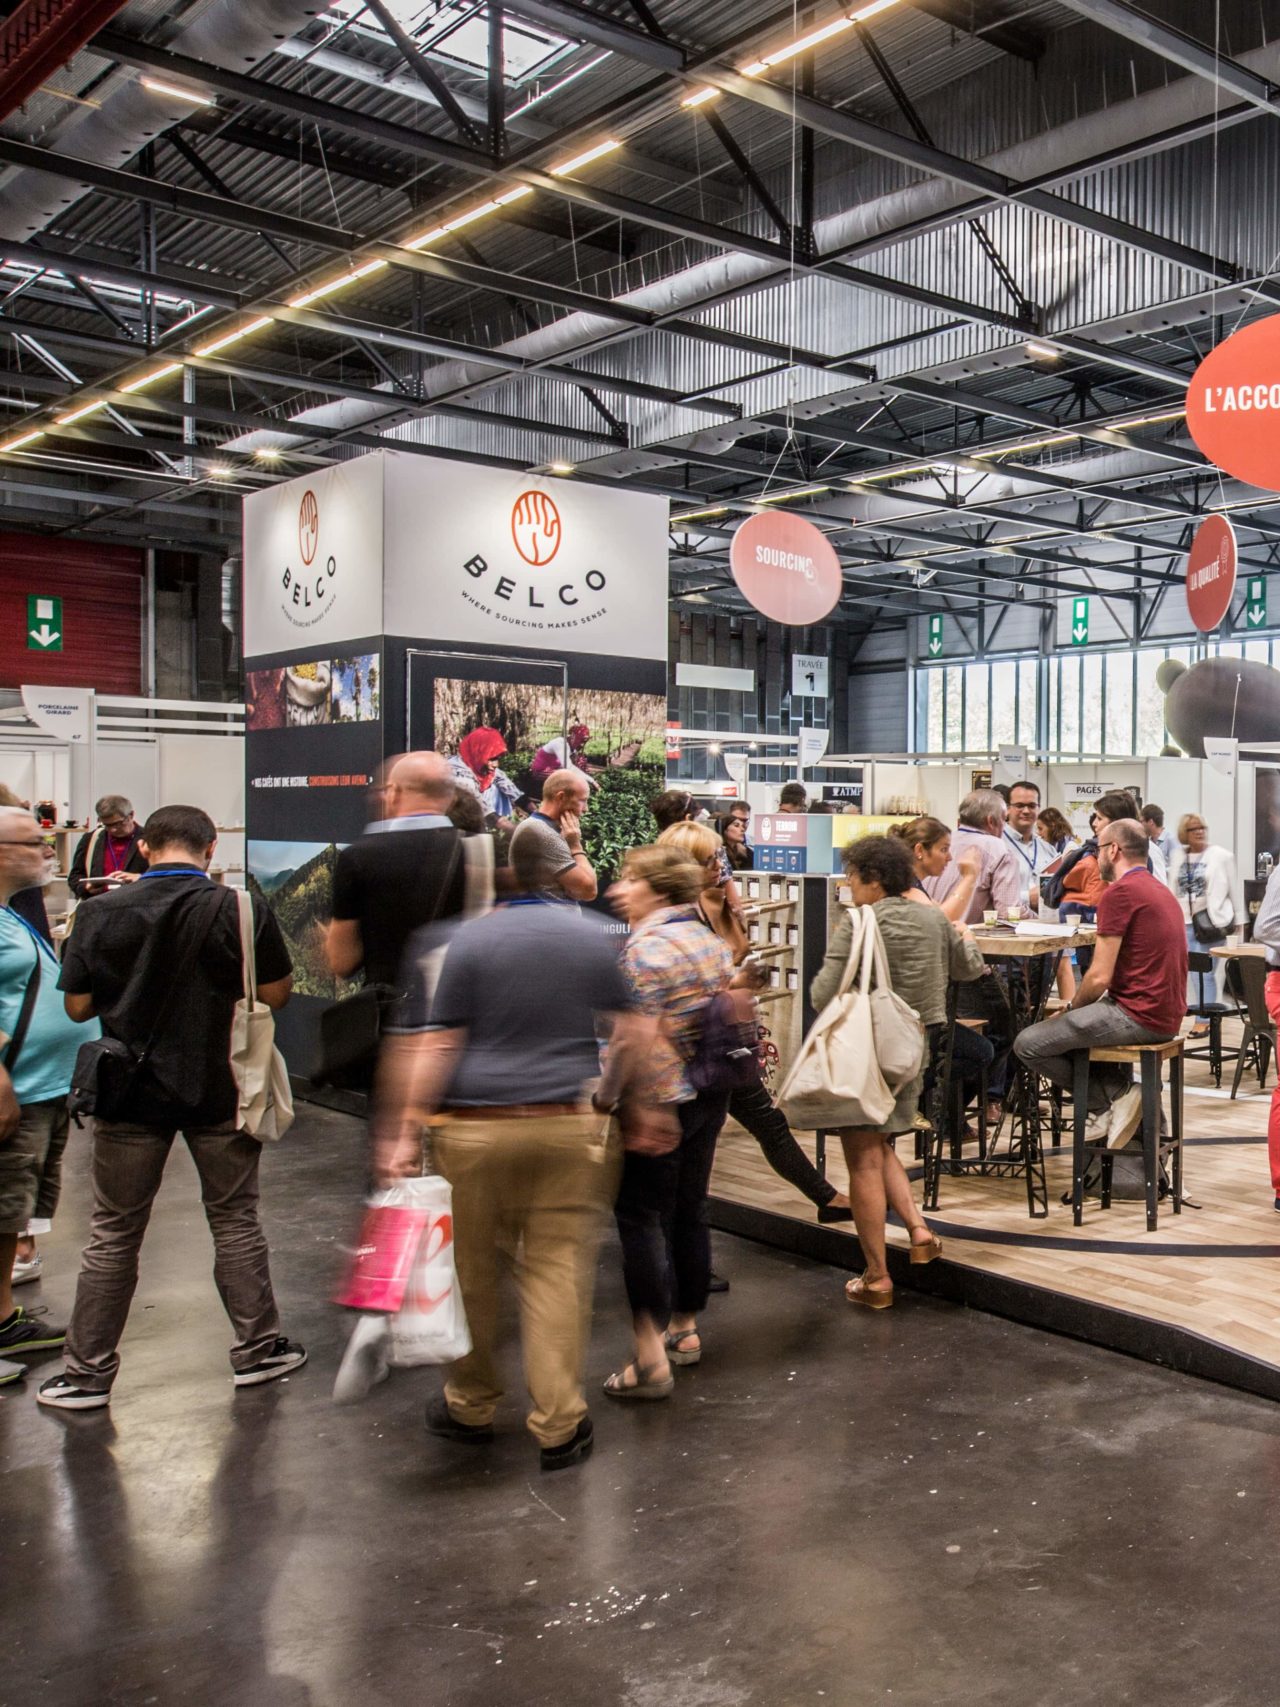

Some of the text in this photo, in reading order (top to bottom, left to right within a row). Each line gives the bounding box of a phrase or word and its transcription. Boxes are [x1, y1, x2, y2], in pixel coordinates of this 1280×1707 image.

[756, 545, 814, 576] SOURCING
[1198, 555, 1219, 589] QUALITÉ
[282, 556, 336, 607] BELCO
[463, 554, 606, 608] BELCO
[462, 590, 607, 629] WHERE SOURCING MAKES SENSE
[797, 660, 824, 670] TRAVÉE
[805, 672, 814, 691] 1
